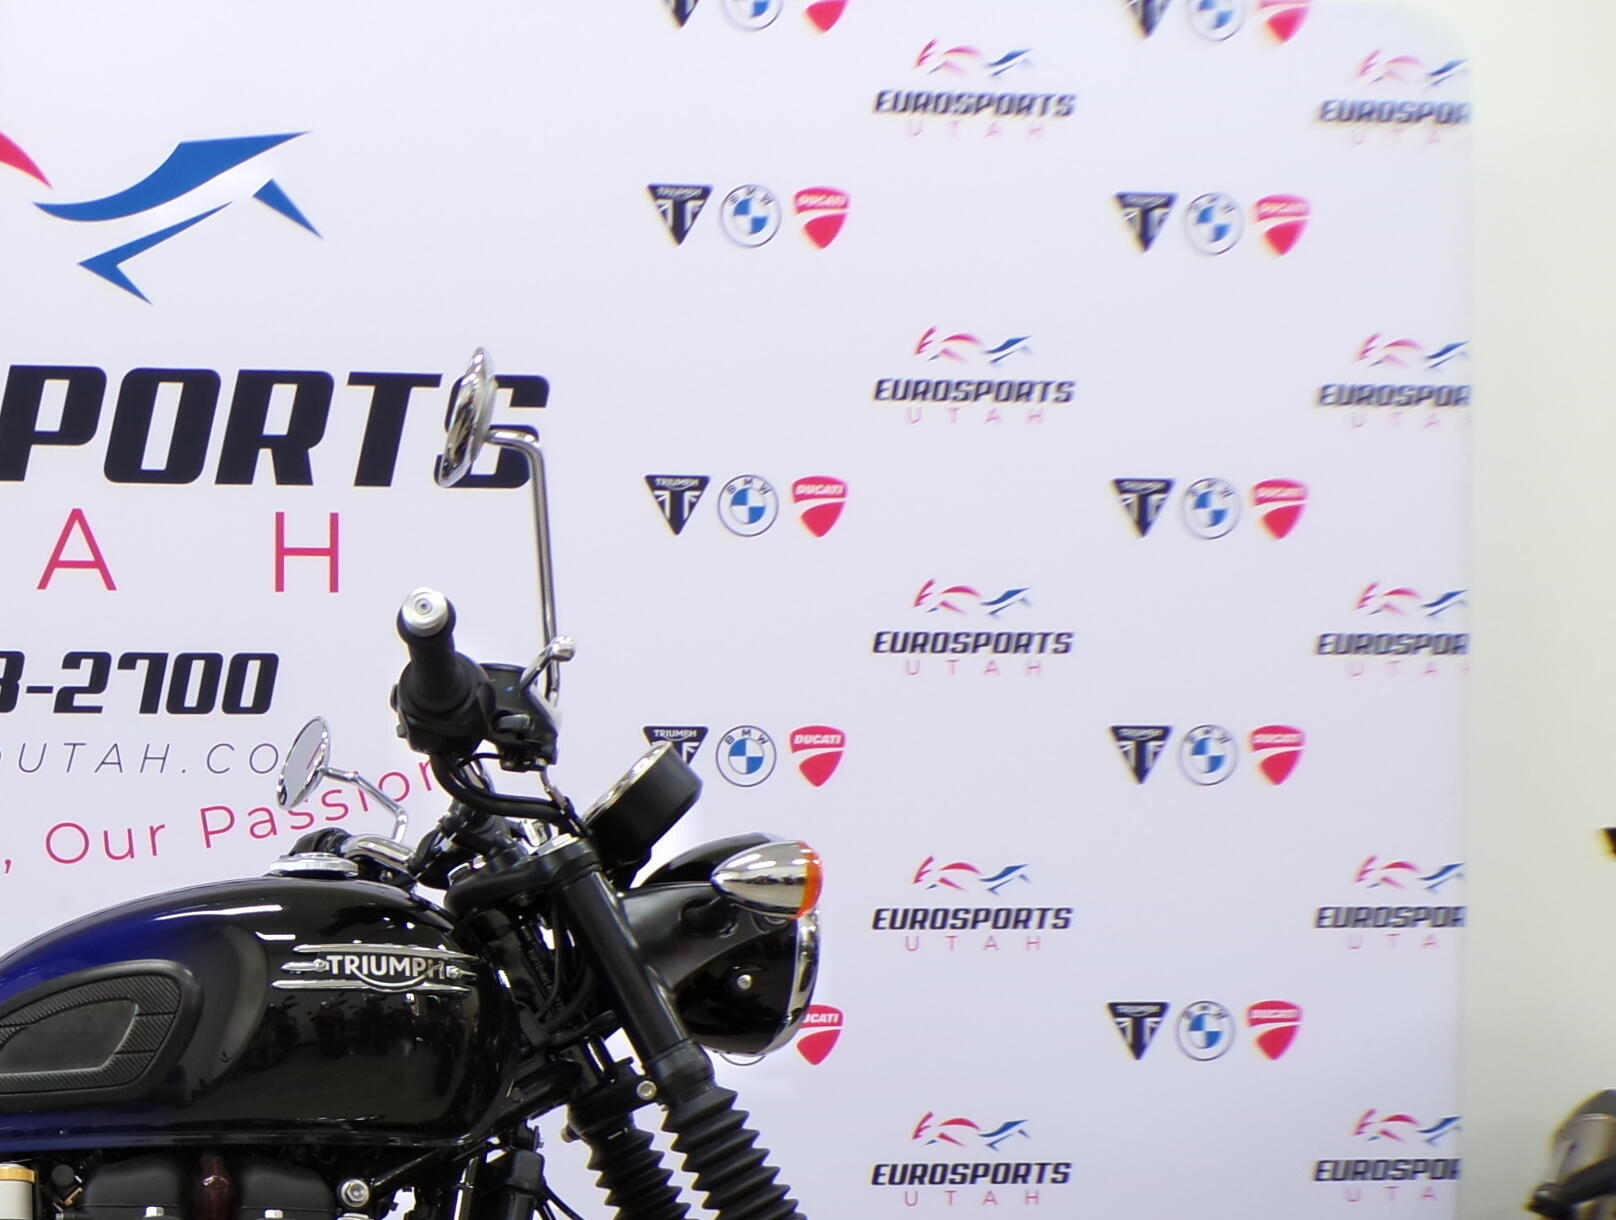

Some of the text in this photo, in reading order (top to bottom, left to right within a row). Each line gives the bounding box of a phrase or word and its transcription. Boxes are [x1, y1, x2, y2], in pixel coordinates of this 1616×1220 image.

[874, 90, 1077, 117] EUROSPORTS
[1318, 99, 1471, 124] EUROSPOR
[873, 378, 1076, 403] EUROSPORTS
[1316, 383, 1471, 407] EUROSPOR
[906, 408, 1043, 423] UTAH
[795, 484, 843, 495] DUCATI
[872, 631, 1074, 654] EUROSPORTS
[1315, 633, 1469, 656] EUROSPOR
[905, 660, 1042, 676] UTAH
[654, 729, 697, 739] TRIUMPH
[725, 728, 769, 745] BMW
[794, 734, 842, 745] DUCATI
[45, 821, 166, 865] Our
[872, 907, 1073, 930] EUROSPORTS
[1314, 906, 1467, 928] EUROSPOR
[905, 935, 1041, 952] UTAH
[326, 954, 446, 980] TRIUMPH
[802, 1012, 839, 1024] UCATI
[871, 1163, 1072, 1185] EUROSPORTS
[904, 1191, 1039, 1207] UTAH
[1345, 1186, 1437, 1202] UTA
